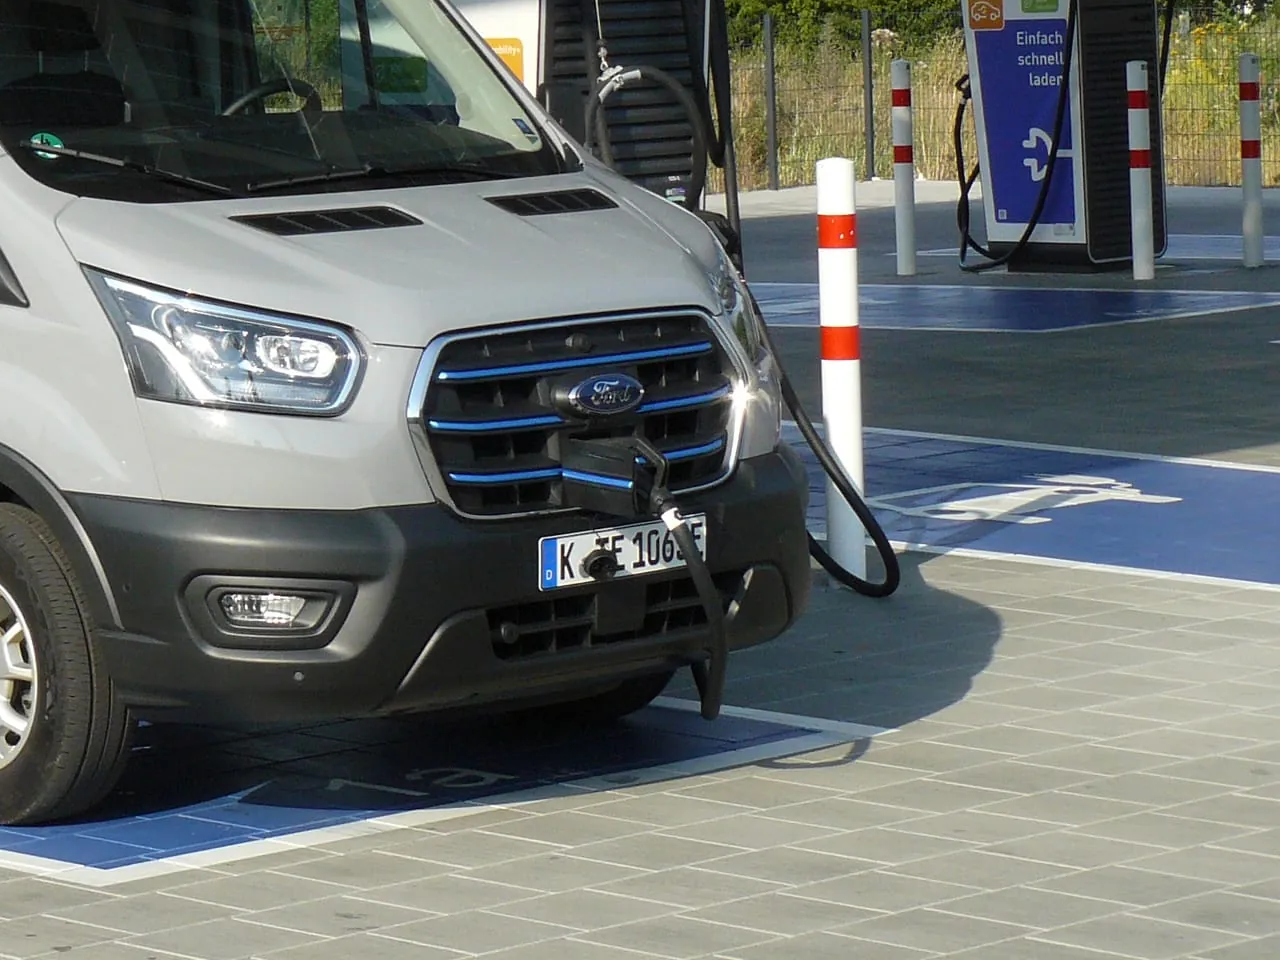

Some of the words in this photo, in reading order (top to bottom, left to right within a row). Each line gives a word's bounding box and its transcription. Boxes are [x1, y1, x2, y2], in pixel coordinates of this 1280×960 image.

[1016, 30, 1063, 46] Einfach
[1017, 51, 1065, 66] schnell
[591, 379, 632, 406] Ford
[560, 541, 575, 581] K
[545, 569, 553, 581] D
